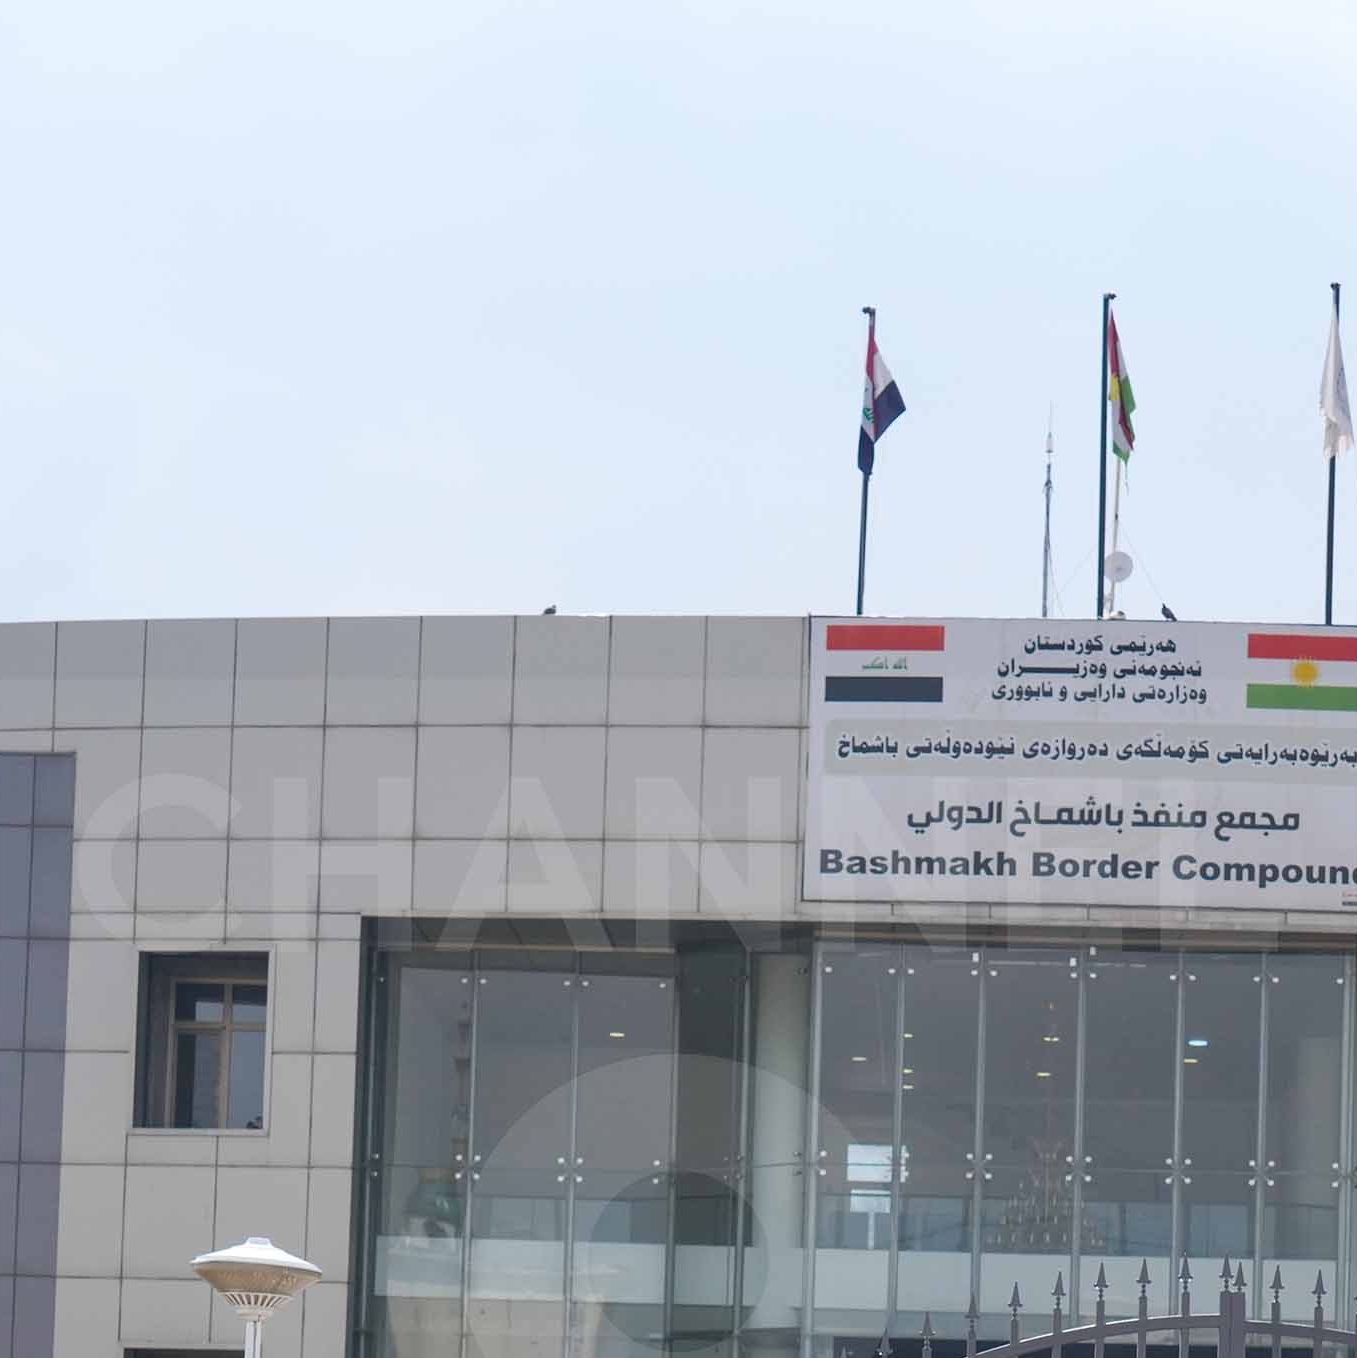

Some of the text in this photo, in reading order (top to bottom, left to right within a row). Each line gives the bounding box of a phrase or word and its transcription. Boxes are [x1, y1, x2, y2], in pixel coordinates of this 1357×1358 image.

[838, 734, 899, 758] باشماخ
[907, 800, 1003, 835] الدولي
[1131, 801, 1207, 828] منفذ
[1214, 811, 1300, 842] مجمع
[819, 849, 1017, 877] Bashmakh
[1032, 852, 1160, 880] Border
